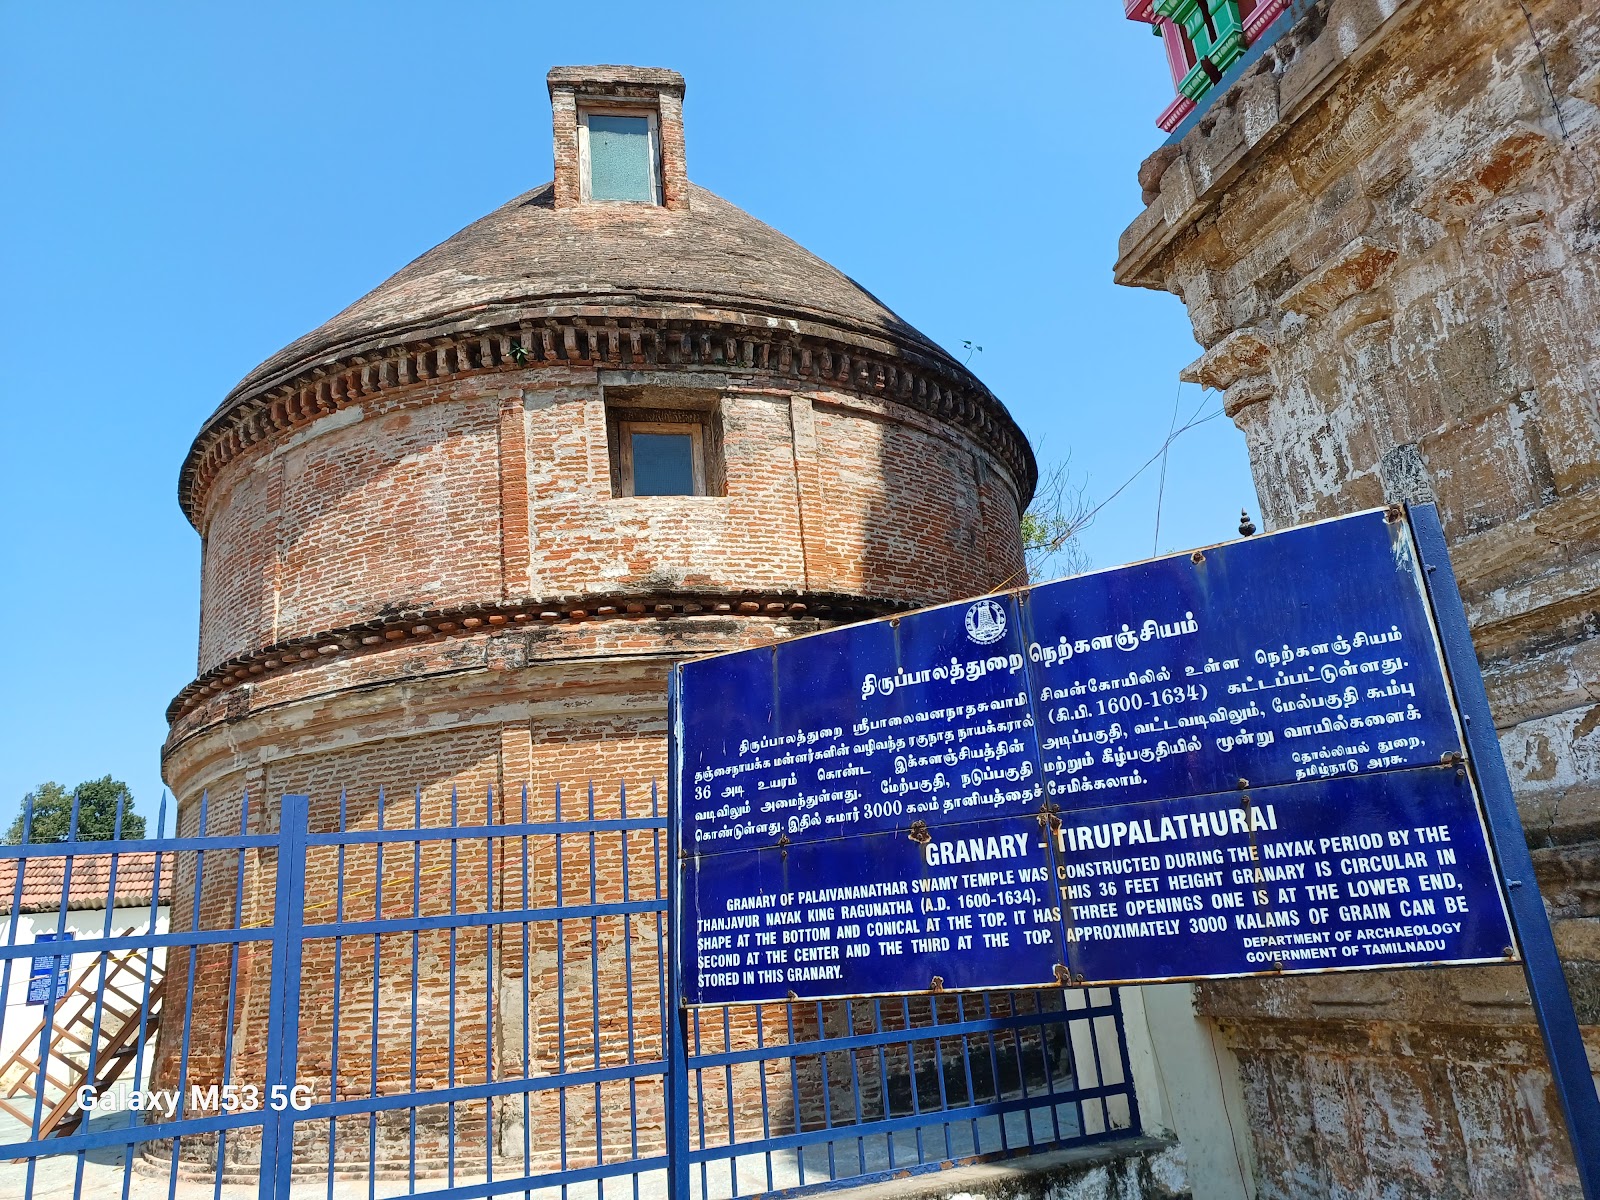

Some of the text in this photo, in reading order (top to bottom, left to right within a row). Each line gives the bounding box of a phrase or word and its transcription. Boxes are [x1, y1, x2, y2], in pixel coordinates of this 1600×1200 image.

[739, 626, 1402, 756] திருப்பாலத்துறை ஸ்ரீபாலைவனநாதசுவாமி சிவன்கோயிலில் உள்ள நெற்களஞ்சியம்
[862, 654, 1023, 700] திருப்பாலத்துறை
[1029, 612, 1198, 667] நெற்களஞ்சியம்
[695, 658, 1408, 784] தஞ்சைநாயக்க மன்னர்களின் வழிவந்த ரகுநாத நாயக்கரால் (கி.பி. 1600-1634) கட்டப்பட்டுள்ளது.
[695, 679, 1415, 800] 36 அடி உயரம் கொண்ட இக்களஞ்சியத்தின் அடிப்பகுதி, வட்டவடிவிலும், மேல்பகுதி கூம்பு
[1292, 737, 1425, 764] தொல்லியல் துறை,
[695, 709, 1421, 822] வடிவிலும் அமைந்துள்ளது. மேற்பகுதி, நடுப்பகுதி மற்றும் கீழ்பகுதியில் மூன்று வாயில்களைக்
[1296, 756, 1407, 780] தமிழ்நாடு அரசு.
[695, 769, 1147, 841] கொண்டுள்ளது. இதில் சுமார் 3000 கலம் தானியத்தைச் சேமிக்கலாம்.
[925, 835, 1028, 866] GRANARY
[1056, 805, 1277, 852] TIRUPALATHURAI
[697, 849, 1456, 932] THANJAVUR NAYAK KING RAGUNATHA (A.D. 1600-1634). THIS 36 FEET HEIGHT GRANARY IS CIRCULAR IN
[727, 825, 1450, 911] GRANARY OF PALAIVANANATHAR SWAMY TEMPLE WAS CONSTRUCTED DURING THE NAYAK PERIOD BY THE
[698, 873, 1462, 950] SHAPE AT THE BOTTOM AND CONICAL AT THE TOP. IT HAS THREE OPENINGS ONE IS AT THE LOWER END,
[698, 896, 1469, 969] SECOND AT THE CENTER AND THE THIRD AT THE TOP. APPROXIMATELY 3000 KALAMS OF GRAIN CAN BE
[1243, 923, 1461, 947] DEPARTMENT OF ARCHAEOLOGY
[698, 965, 842, 987] STORED IN THIS GRANARY.
[1247, 940, 1445, 965] GOVERNMENT OF TAMILNADU
